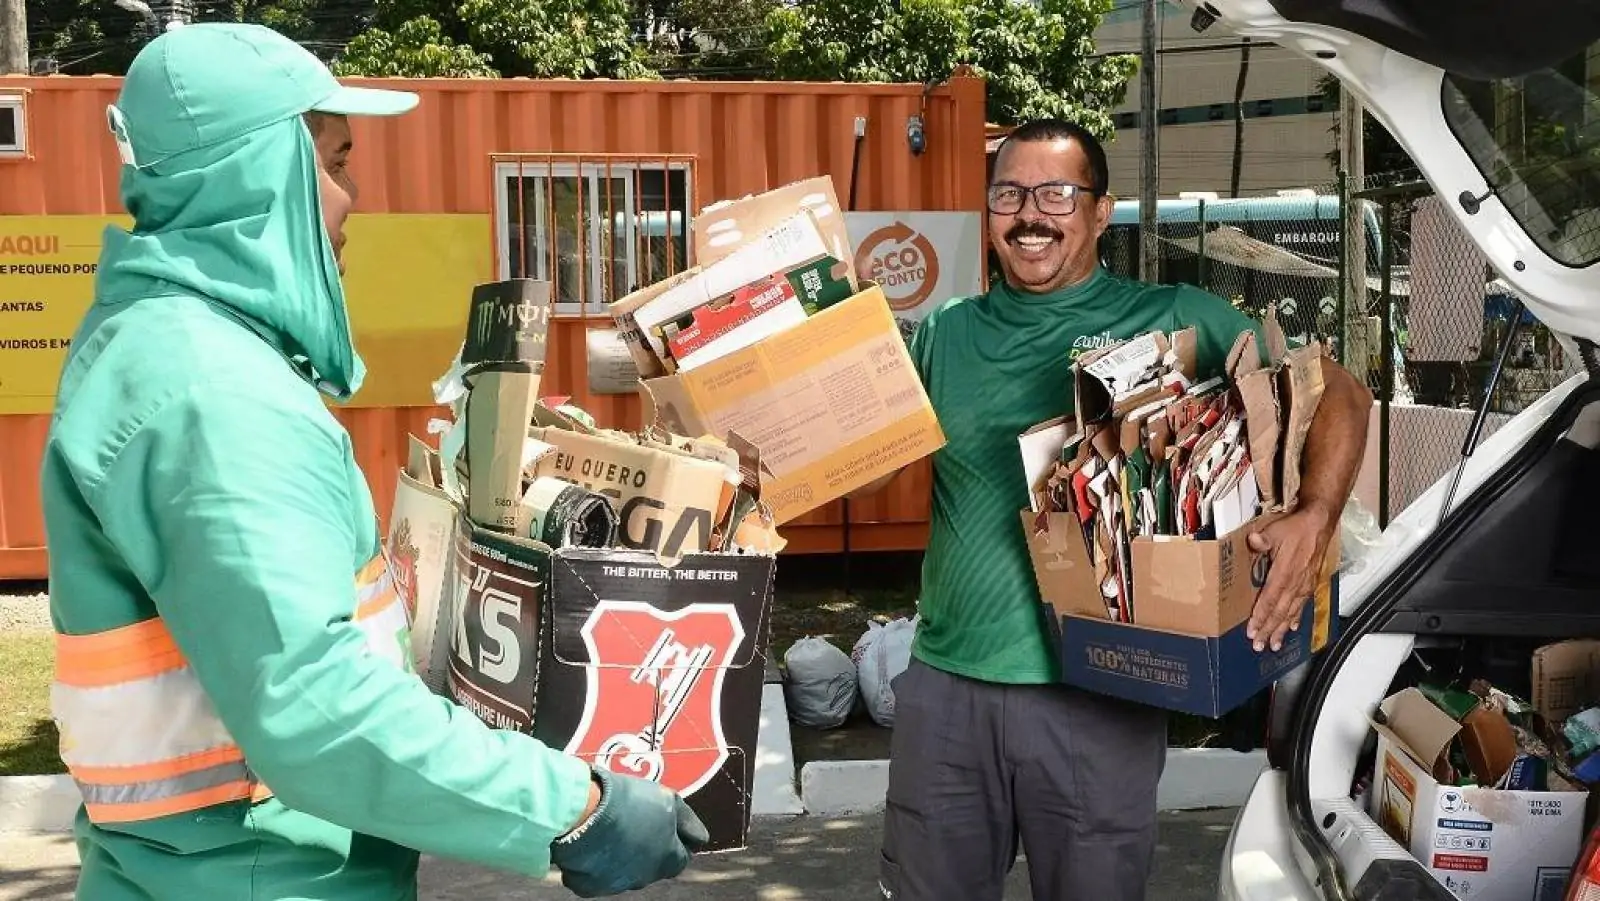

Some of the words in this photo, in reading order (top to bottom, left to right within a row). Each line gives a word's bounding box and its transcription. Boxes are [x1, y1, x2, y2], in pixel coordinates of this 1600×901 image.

[0, 235, 59, 255] AQUI
[10, 264, 70, 275] PEQUENO
[0, 302, 44, 312] ANTAS
[0, 339, 48, 349] VIDROS
[50, 338, 58, 348] E
[555, 452, 574, 471] EU
[580, 458, 647, 488] QUERO
[602, 565, 626, 577] THE
[674, 569, 695, 580] THE
[697, 570, 738, 581] BETTER
[1085, 645, 1131, 673] 100%
[1132, 663, 1190, 686] NATURAIS
